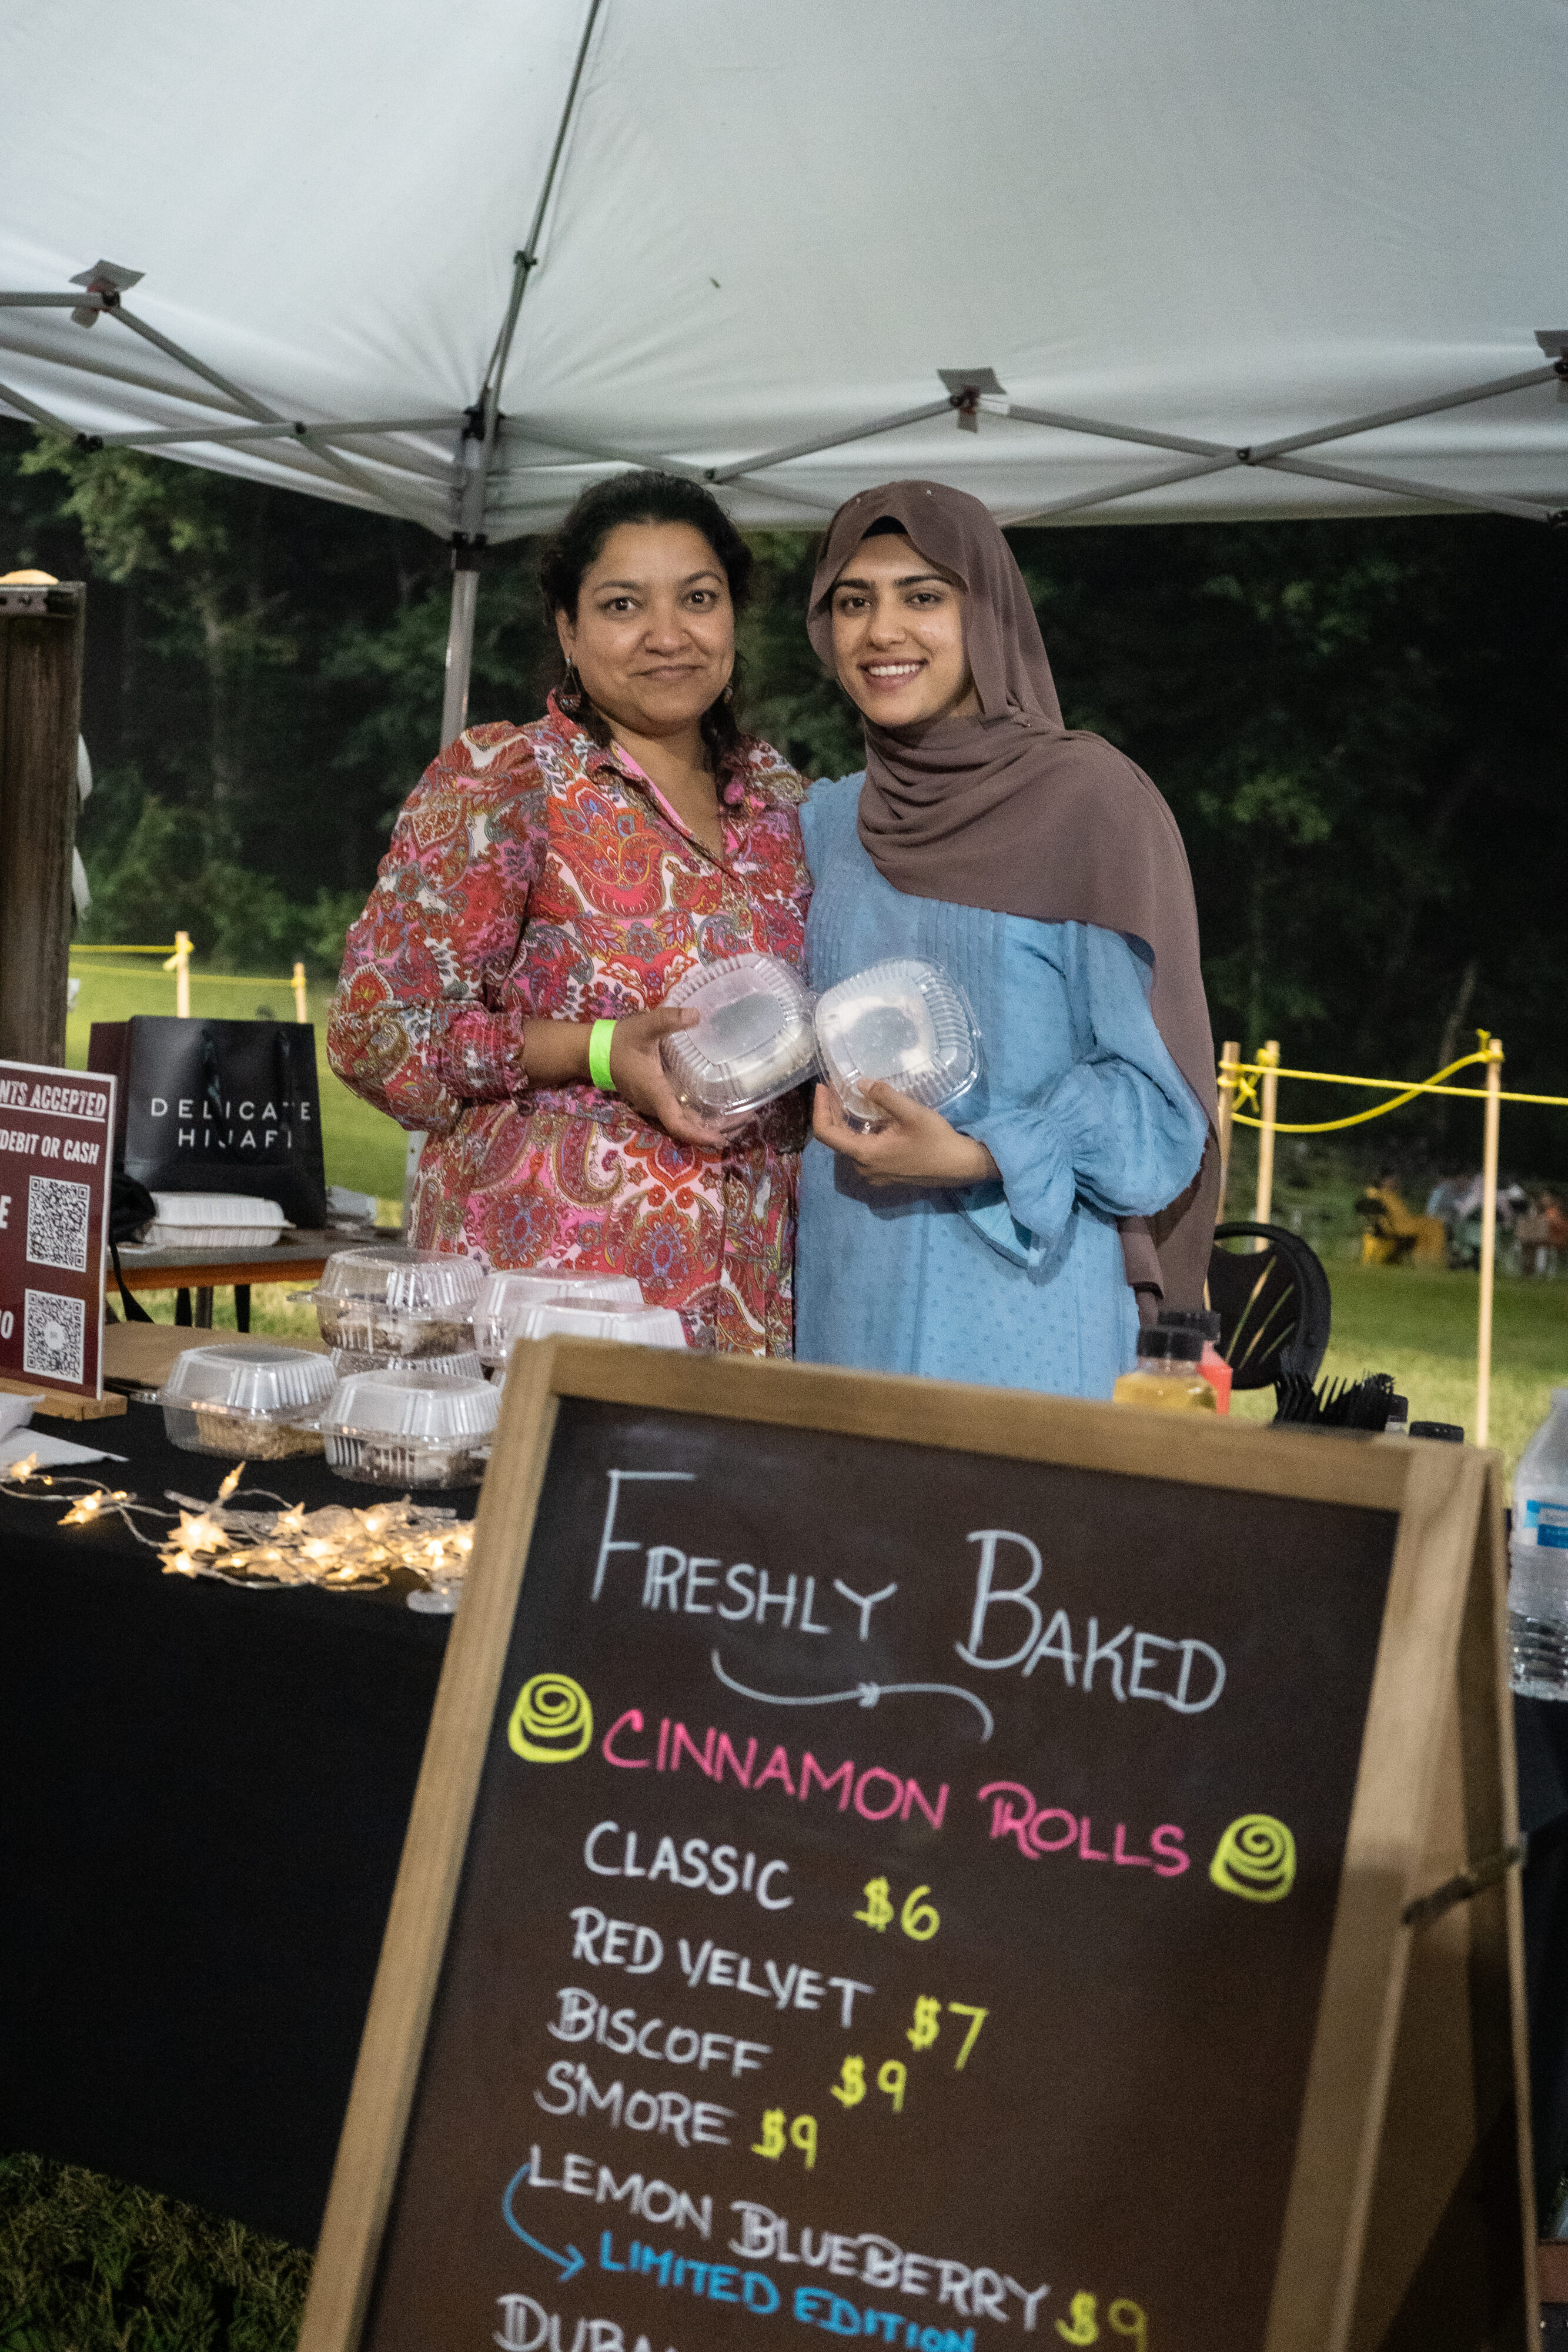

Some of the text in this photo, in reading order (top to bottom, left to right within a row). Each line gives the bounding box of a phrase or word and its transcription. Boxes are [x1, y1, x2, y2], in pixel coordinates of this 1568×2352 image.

[0, 1129, 100, 1165] DEBIT OR CASH
[29, 1084, 107, 1117] ACCEPTED
[151, 1097, 311, 1120] DELICAE
[593, 1468, 1226, 1713] FRESHLY BAKED
[603, 1709, 1190, 1876] CINNAMON ROLLS
[584, 1820, 940, 1941] CLASSIC $6
[570, 1906, 989, 2070] RED VELVET $7
[547, 1986, 907, 2112] BISCOFF $9
[751, 2108, 818, 2170] $9
[528, 2144, 1147, 2352] LEMON BLUEBERRY $9
[600, 2231, 975, 2352] LIMITED EDITION
[494, 2293, 677, 2352] DUB
